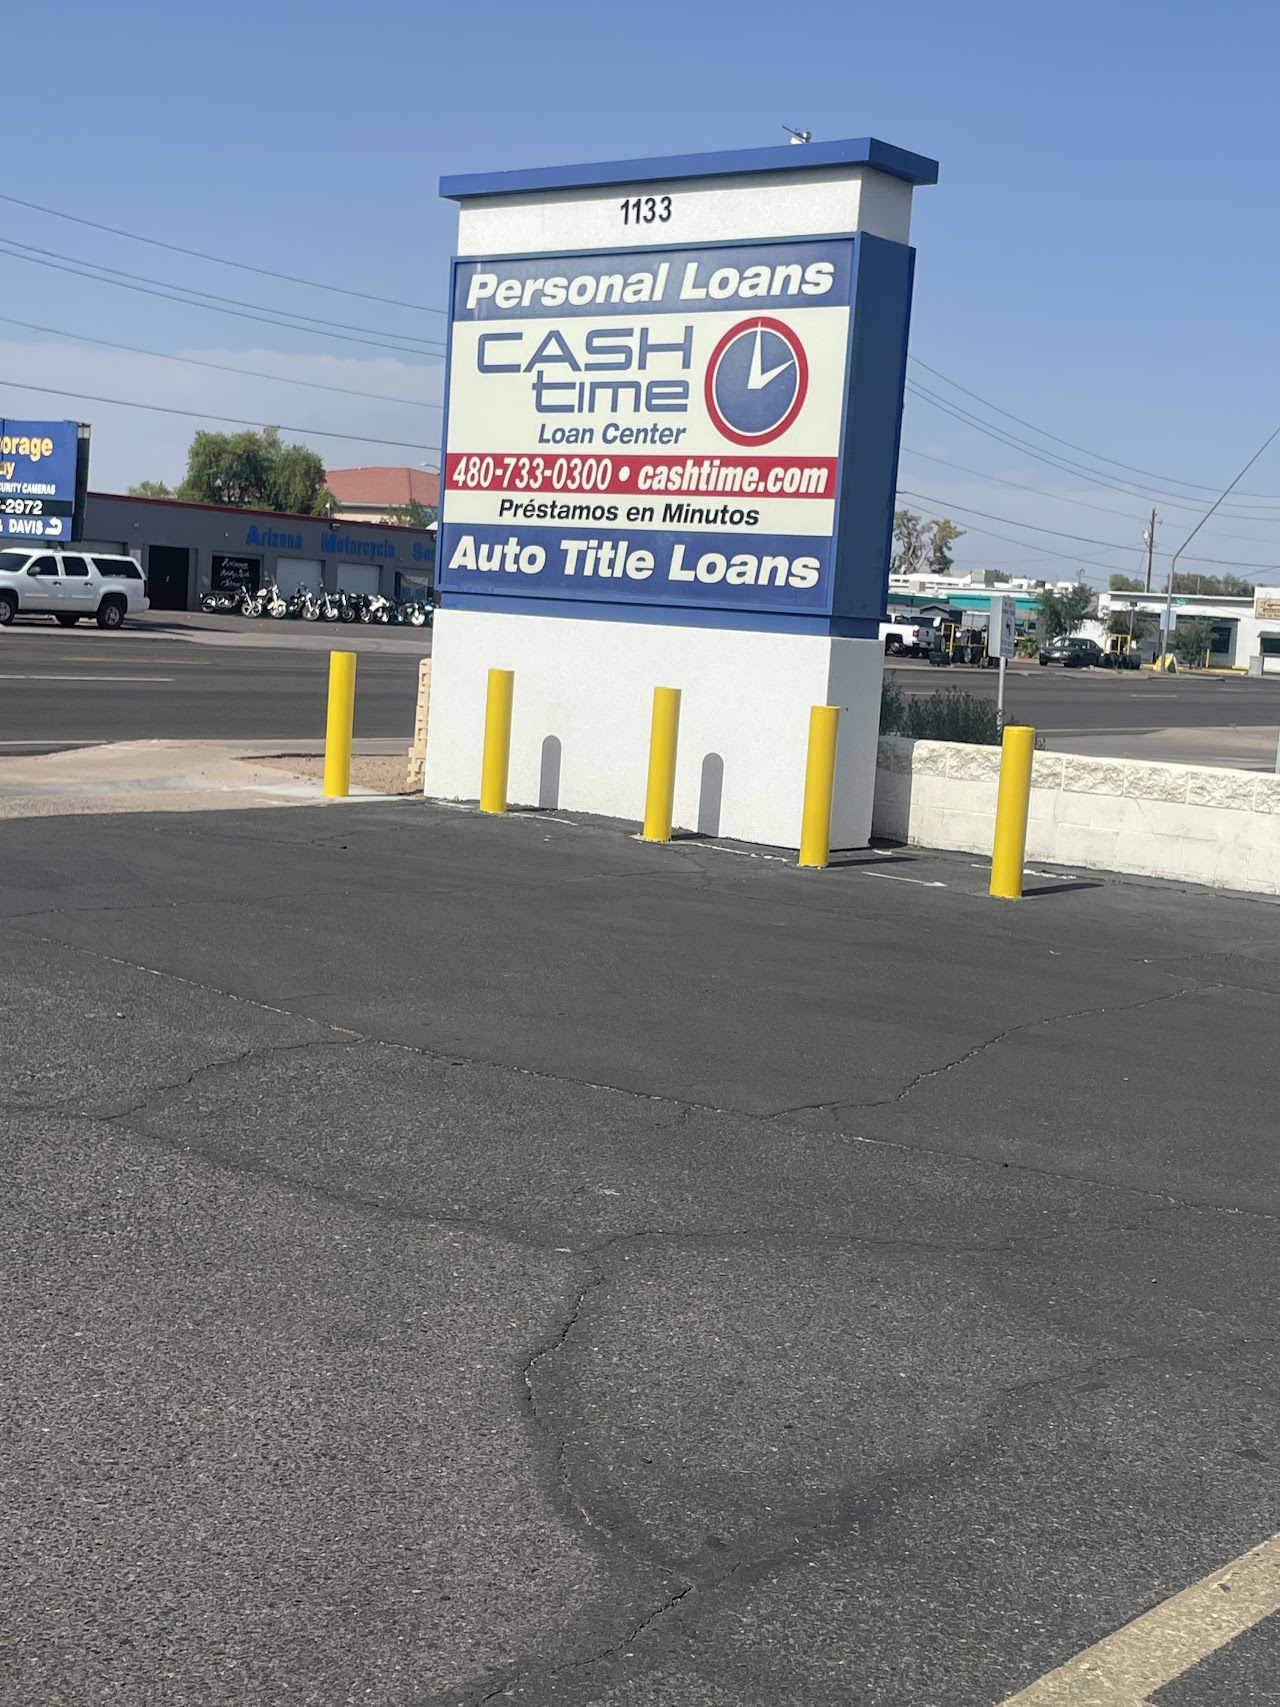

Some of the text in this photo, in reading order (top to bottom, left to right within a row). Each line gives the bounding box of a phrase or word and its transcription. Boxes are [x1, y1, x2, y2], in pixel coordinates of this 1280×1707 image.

[620, 196, 672, 226] 1133
[466, 261, 835, 309] Personal Loans
[477, 325, 694, 373] CASH
[532, 370, 690, 414] time
[538, 422, 687, 445] Loan Center
[0, 436, 53, 462] orage
[0, 482, 56, 496] URITY CAMERAS
[452, 456, 829, 494] 480-733-0300 cashtime.com
[0, 498, 42, 515] -2972
[499, 498, 760, 526] Préstamos en Minutos
[9, 518, 43, 535] DAVIS
[245, 525, 303, 550] Arizona
[321, 532, 395, 560] Motorcycle
[448, 535, 821, 589] Auto Title Loans
